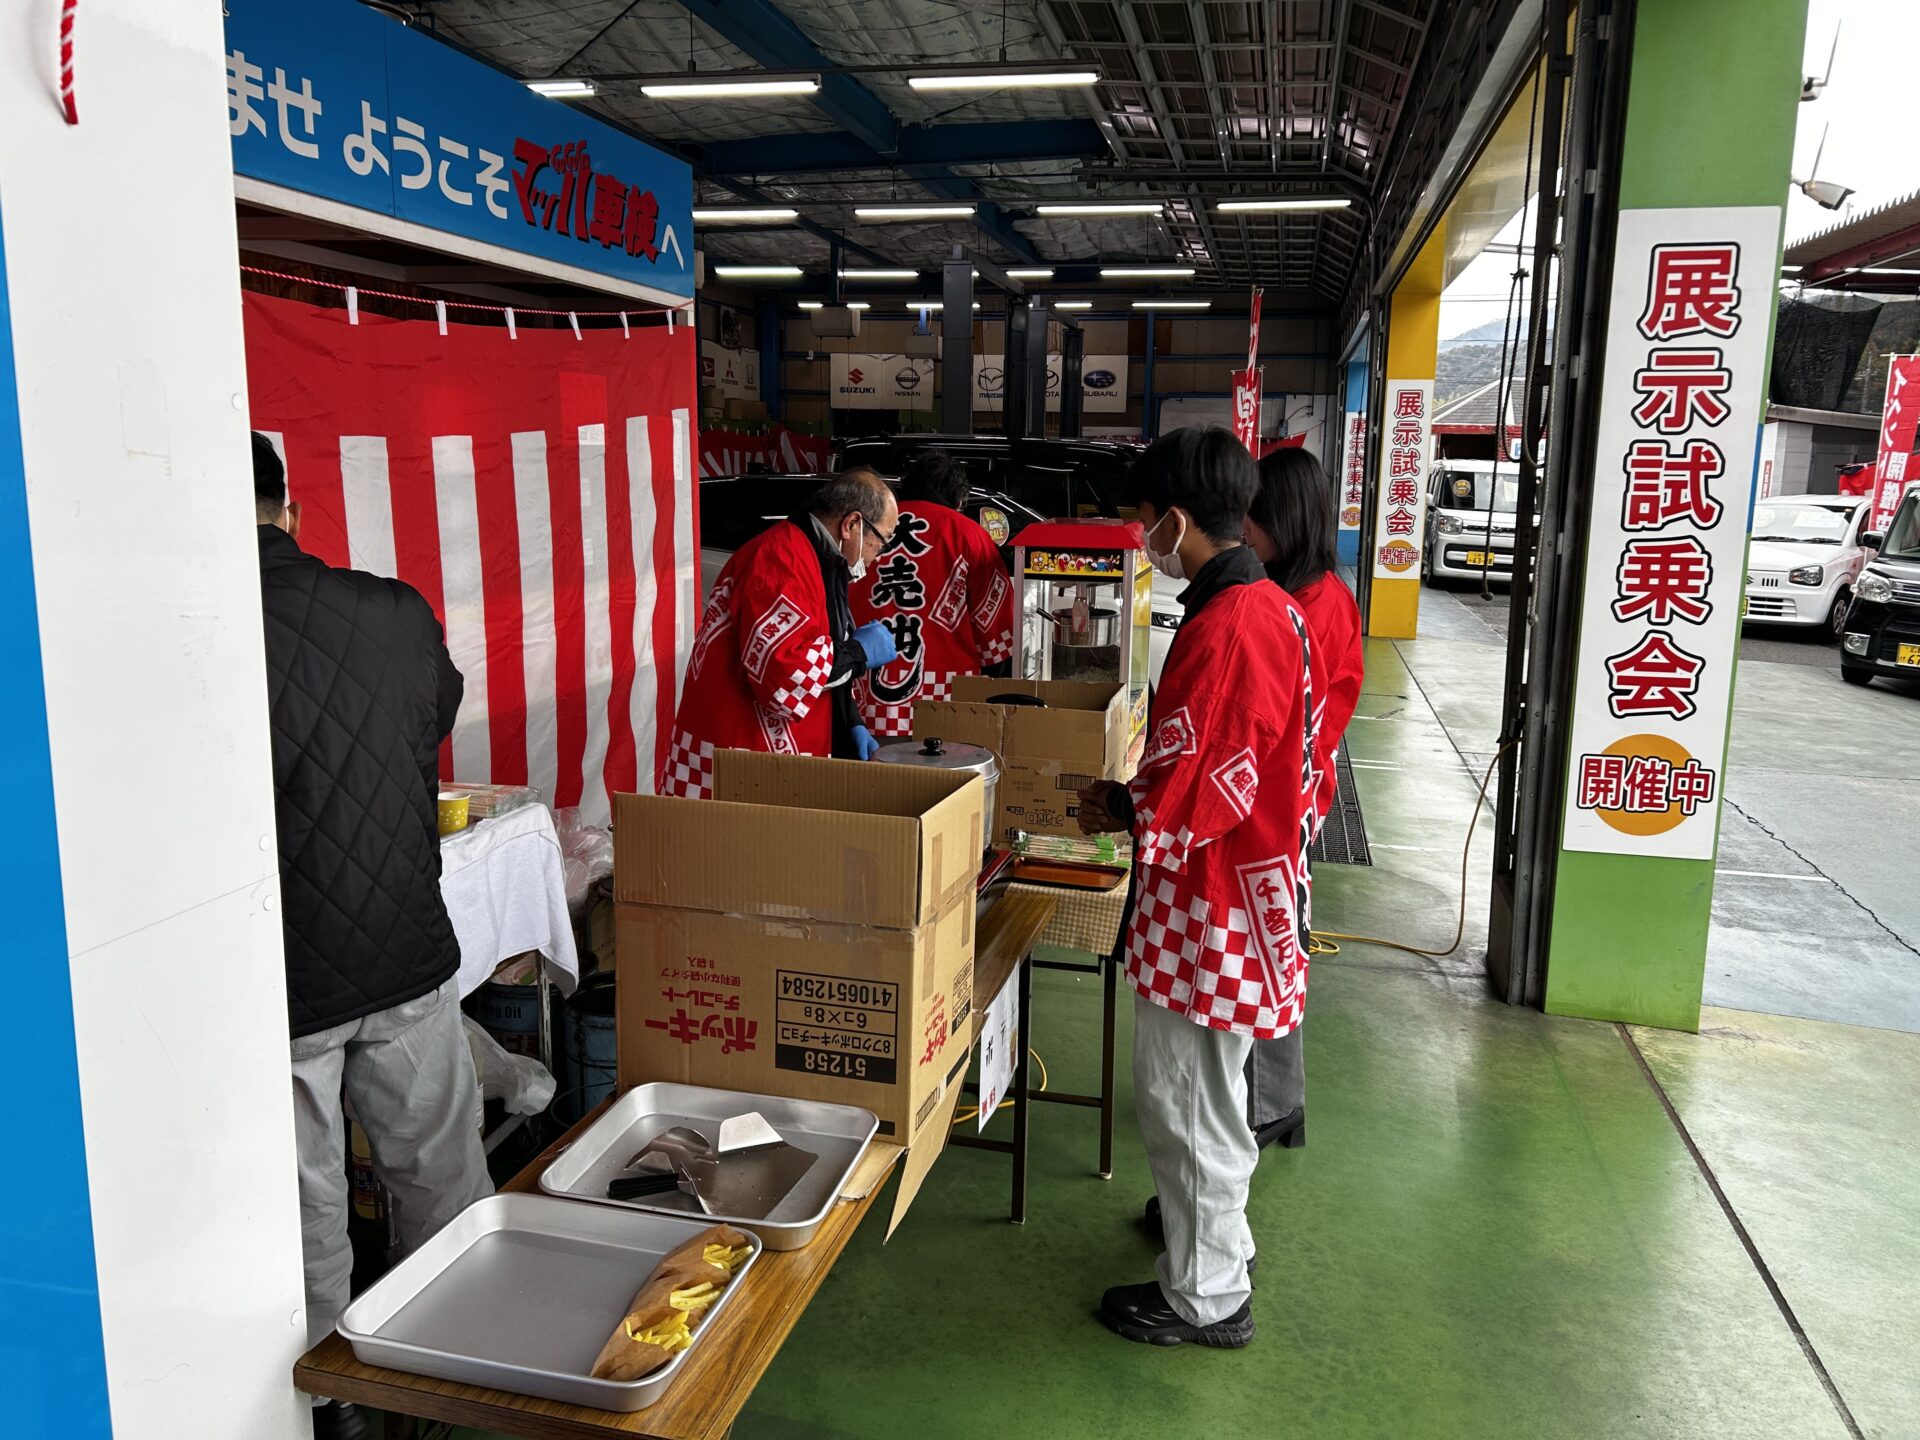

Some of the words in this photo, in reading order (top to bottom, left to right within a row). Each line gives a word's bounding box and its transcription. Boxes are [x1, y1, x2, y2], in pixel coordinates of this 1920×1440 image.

[225, 50, 322, 159] ませ
[1386, 389, 1424, 536] 展示試乗会
[1604, 241, 1742, 721] 展示試乗会
[1378, 547, 1420, 566] 開催中
[1576, 752, 1715, 816] 開催中
[1256, 877, 1296, 991] 千客万来
[660, 967, 741, 988] 便利な小袋タイプ
[782, 976, 892, 1007] 4106512584
[504, 1006, 522, 1019] Oil
[661, 986, 741, 1011] チョコレート
[644, 1008, 758, 1056] ポッキー
[781, 1028, 892, 1054] 8フクロポッキーチョコ
[803, 1050, 867, 1077] 51258
